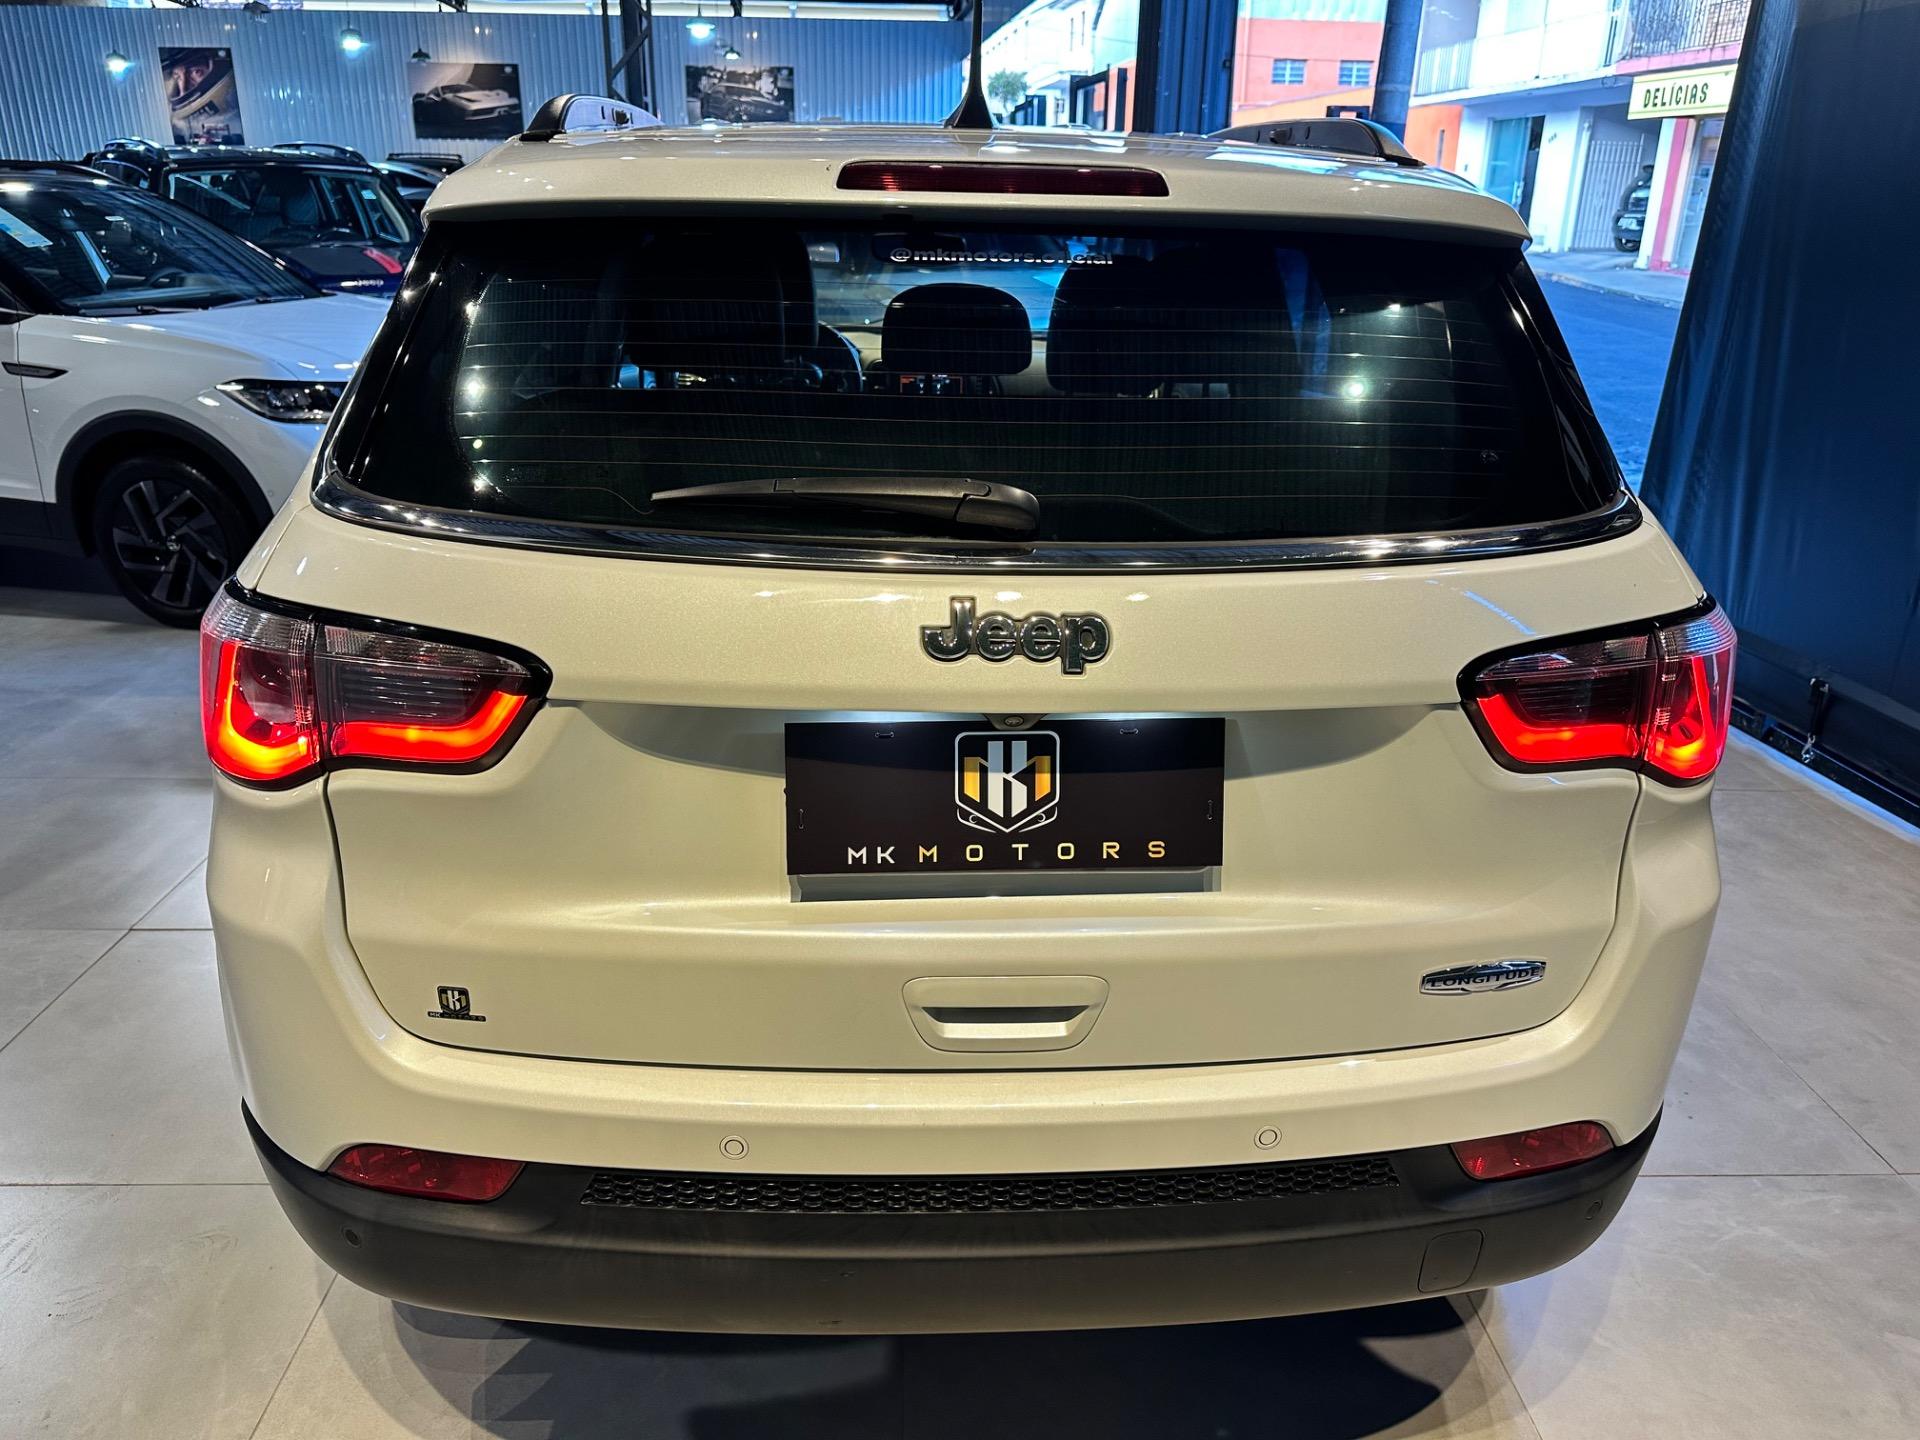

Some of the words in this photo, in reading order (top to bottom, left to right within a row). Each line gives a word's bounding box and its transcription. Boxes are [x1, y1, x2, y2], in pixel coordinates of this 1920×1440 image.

[1643, 82, 1709, 108] DELÍCIAS
[920, 596, 1110, 675] Jeep
[1430, 969, 1540, 988] LONGITUDE
